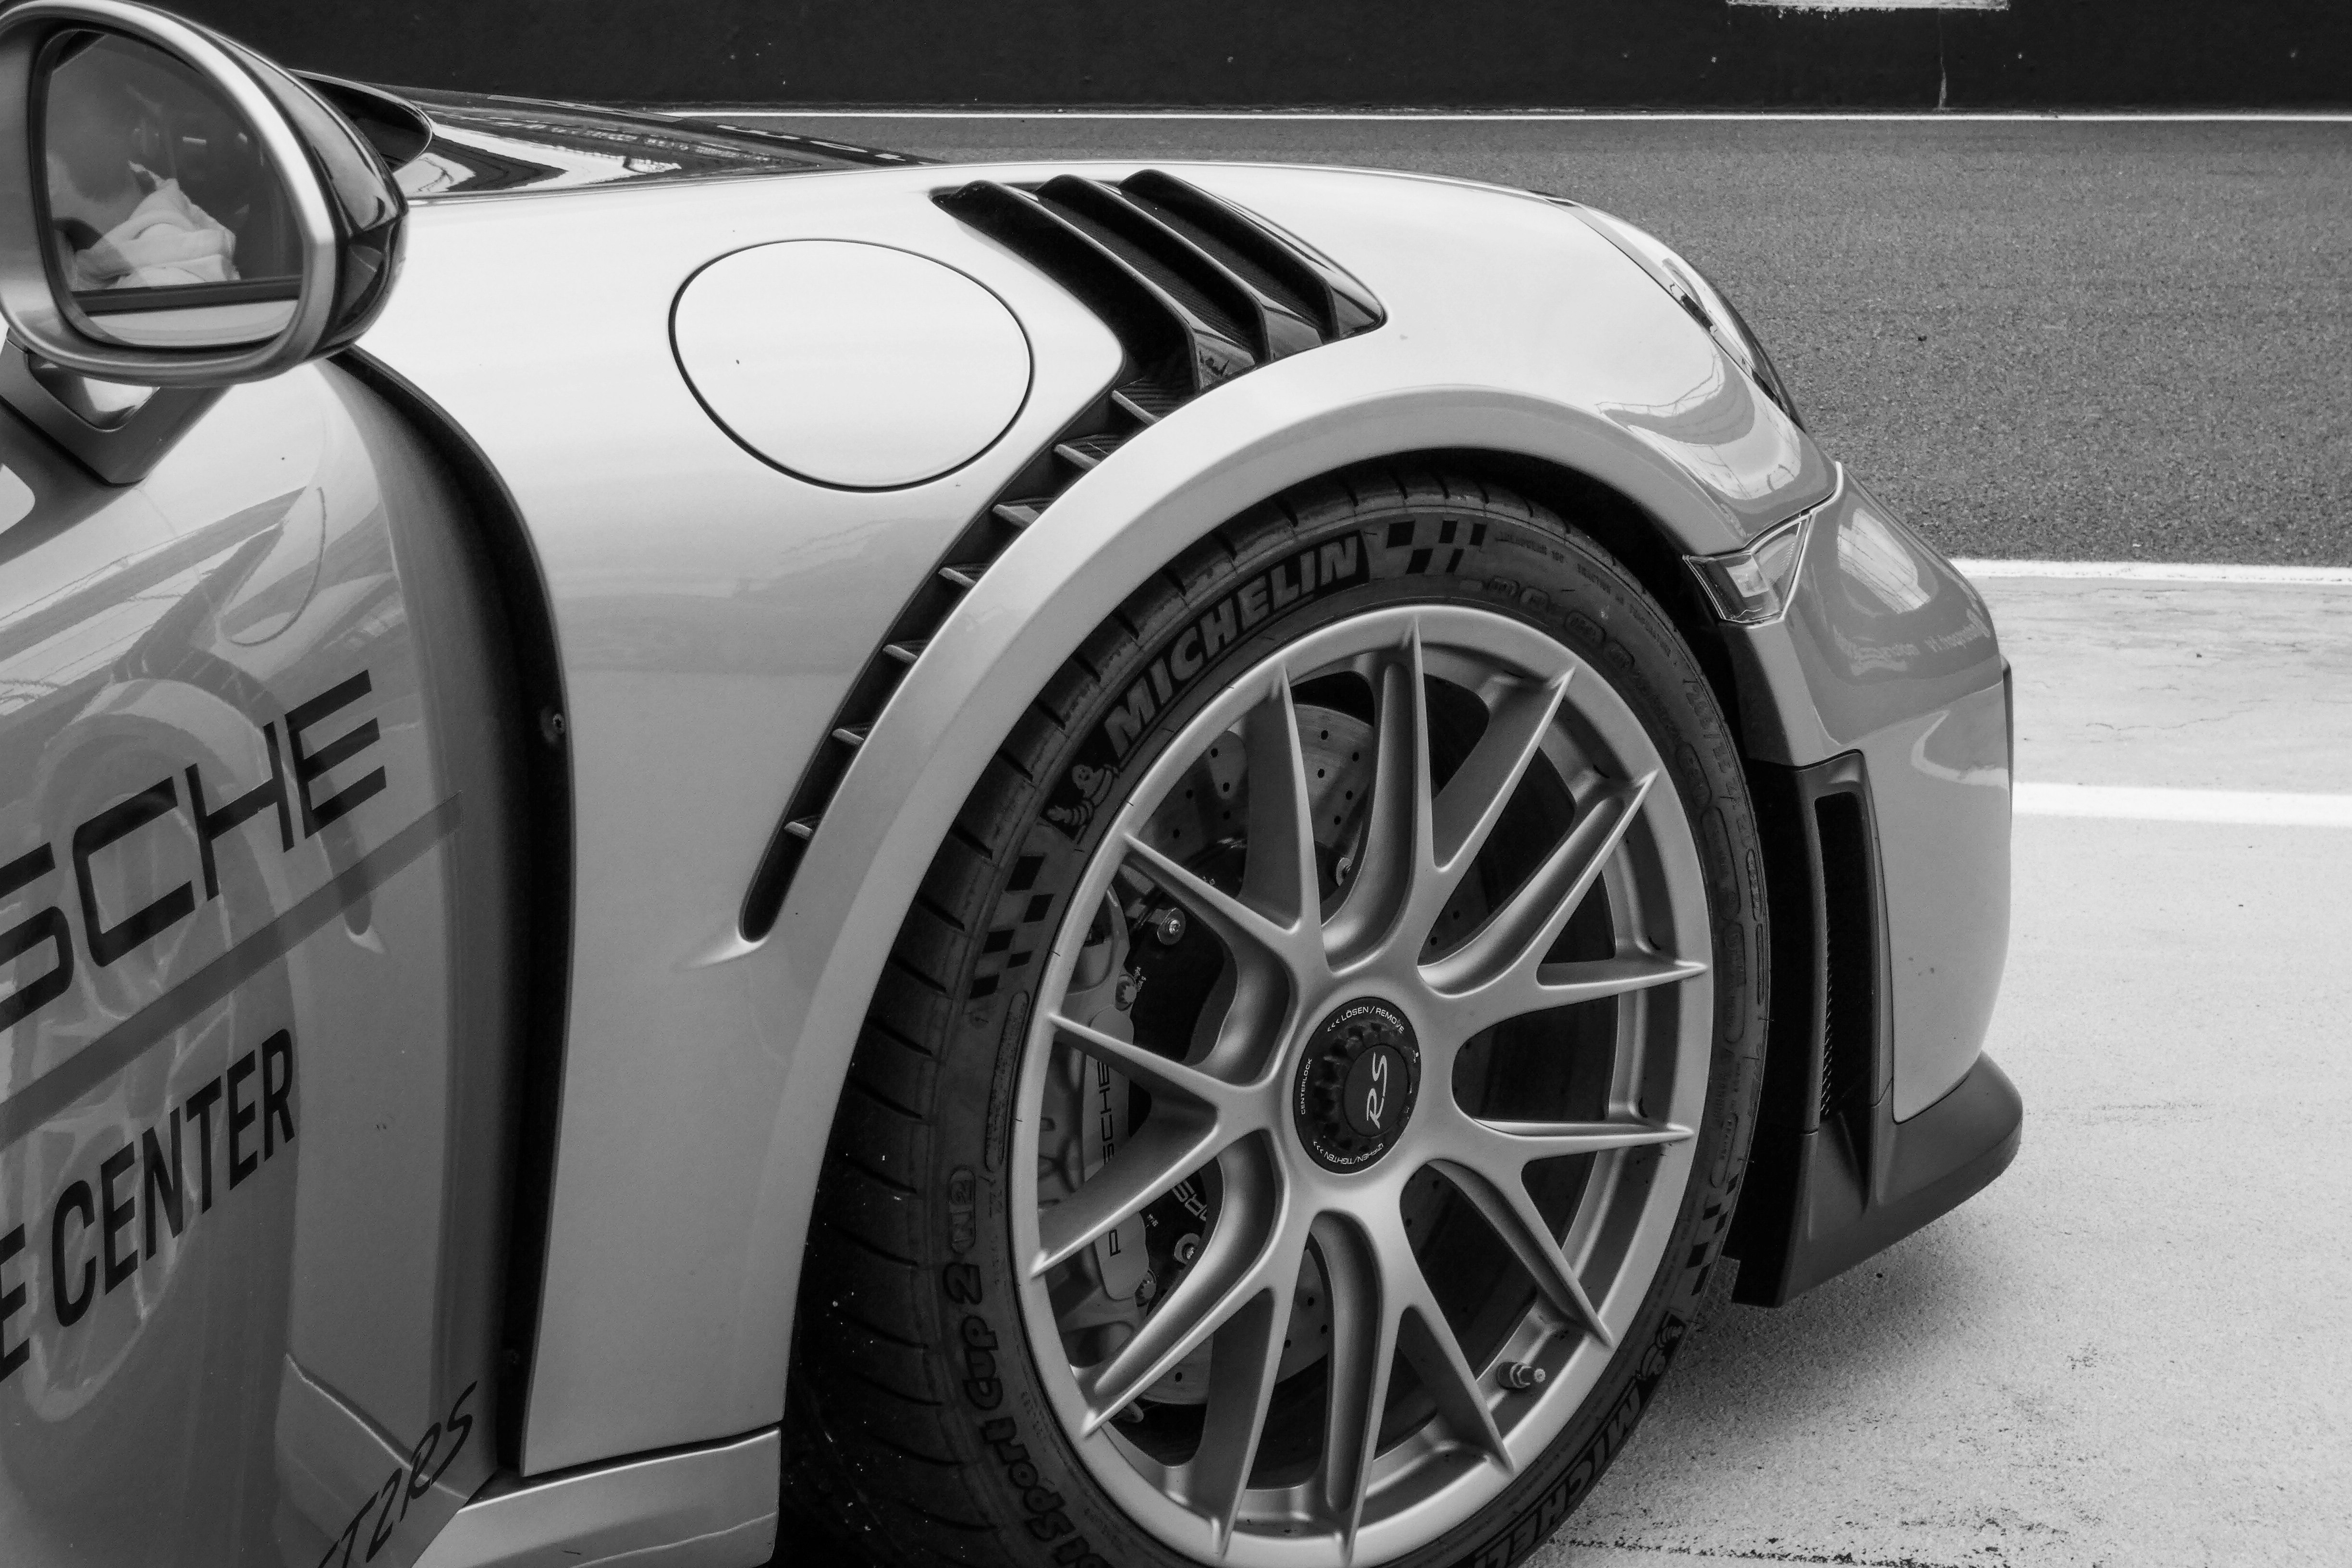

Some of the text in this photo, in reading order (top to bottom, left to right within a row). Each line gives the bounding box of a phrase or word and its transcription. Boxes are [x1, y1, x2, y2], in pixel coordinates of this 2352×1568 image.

[1105, 536, 1358, 757] MICHELIN
[1300, 1058, 1312, 1115] CENTERLOCK
[1367, 1052, 1387, 1129] RS
[51, 1028, 295, 1327] CENTER
[943, 1262, 983, 1306] 2
[961, 1314, 1004, 1411] Cup
[979, 1416, 1077, 1542] Sport
[1473, 1386, 1641, 1568] MICHEL
